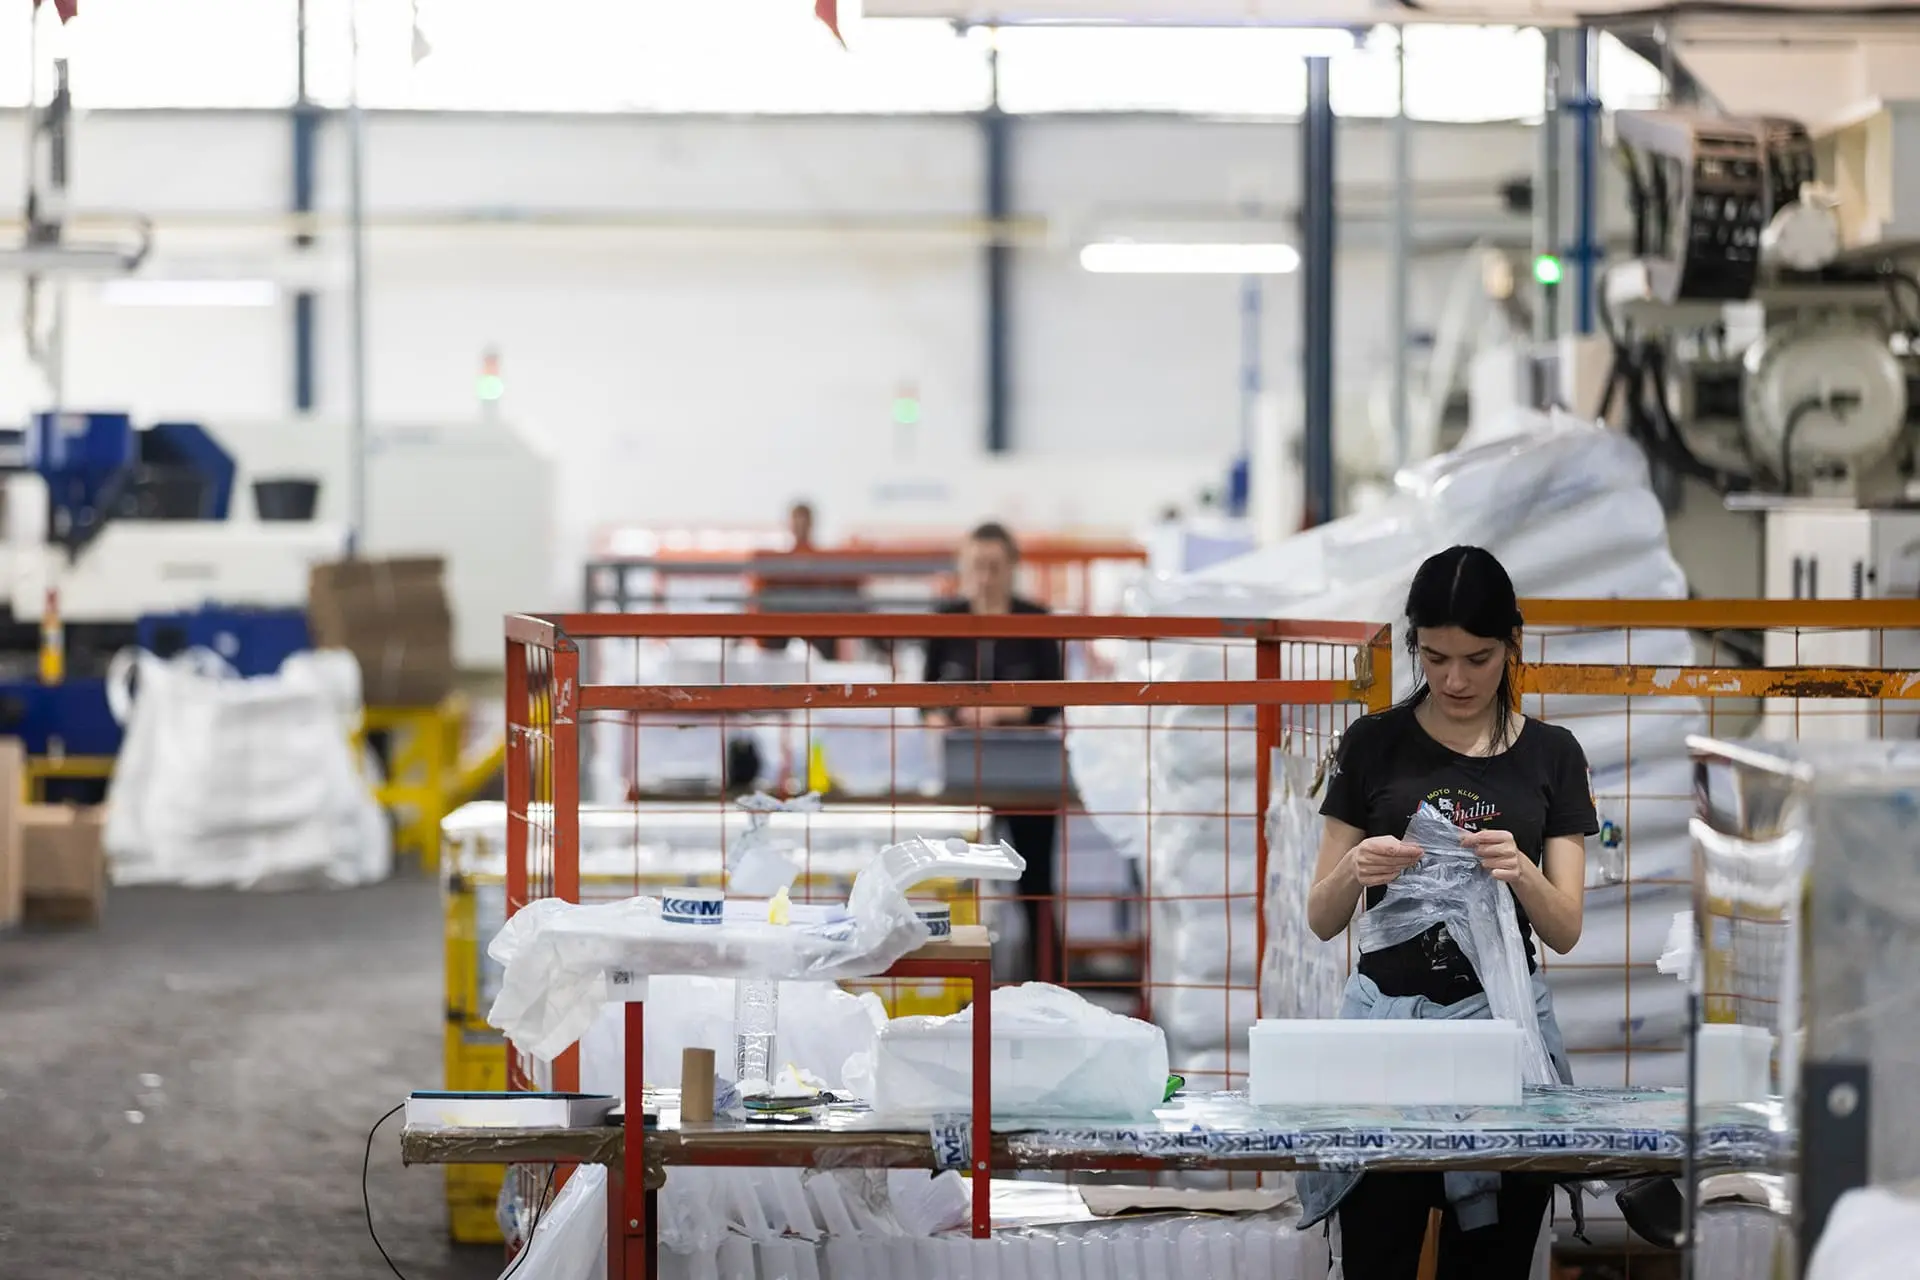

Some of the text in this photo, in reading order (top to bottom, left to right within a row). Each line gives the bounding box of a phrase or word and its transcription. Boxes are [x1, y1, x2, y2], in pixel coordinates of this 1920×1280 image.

[1427, 788, 1480, 801] MOTO KLUB
[1241, 1133, 1293, 1152] MPK
[1329, 1133, 1384, 1148] MPK
[1421, 1134, 1476, 1150] MPK
[1511, 1134, 1566, 1149] MPK
[1602, 1135, 1658, 1151] MPK
